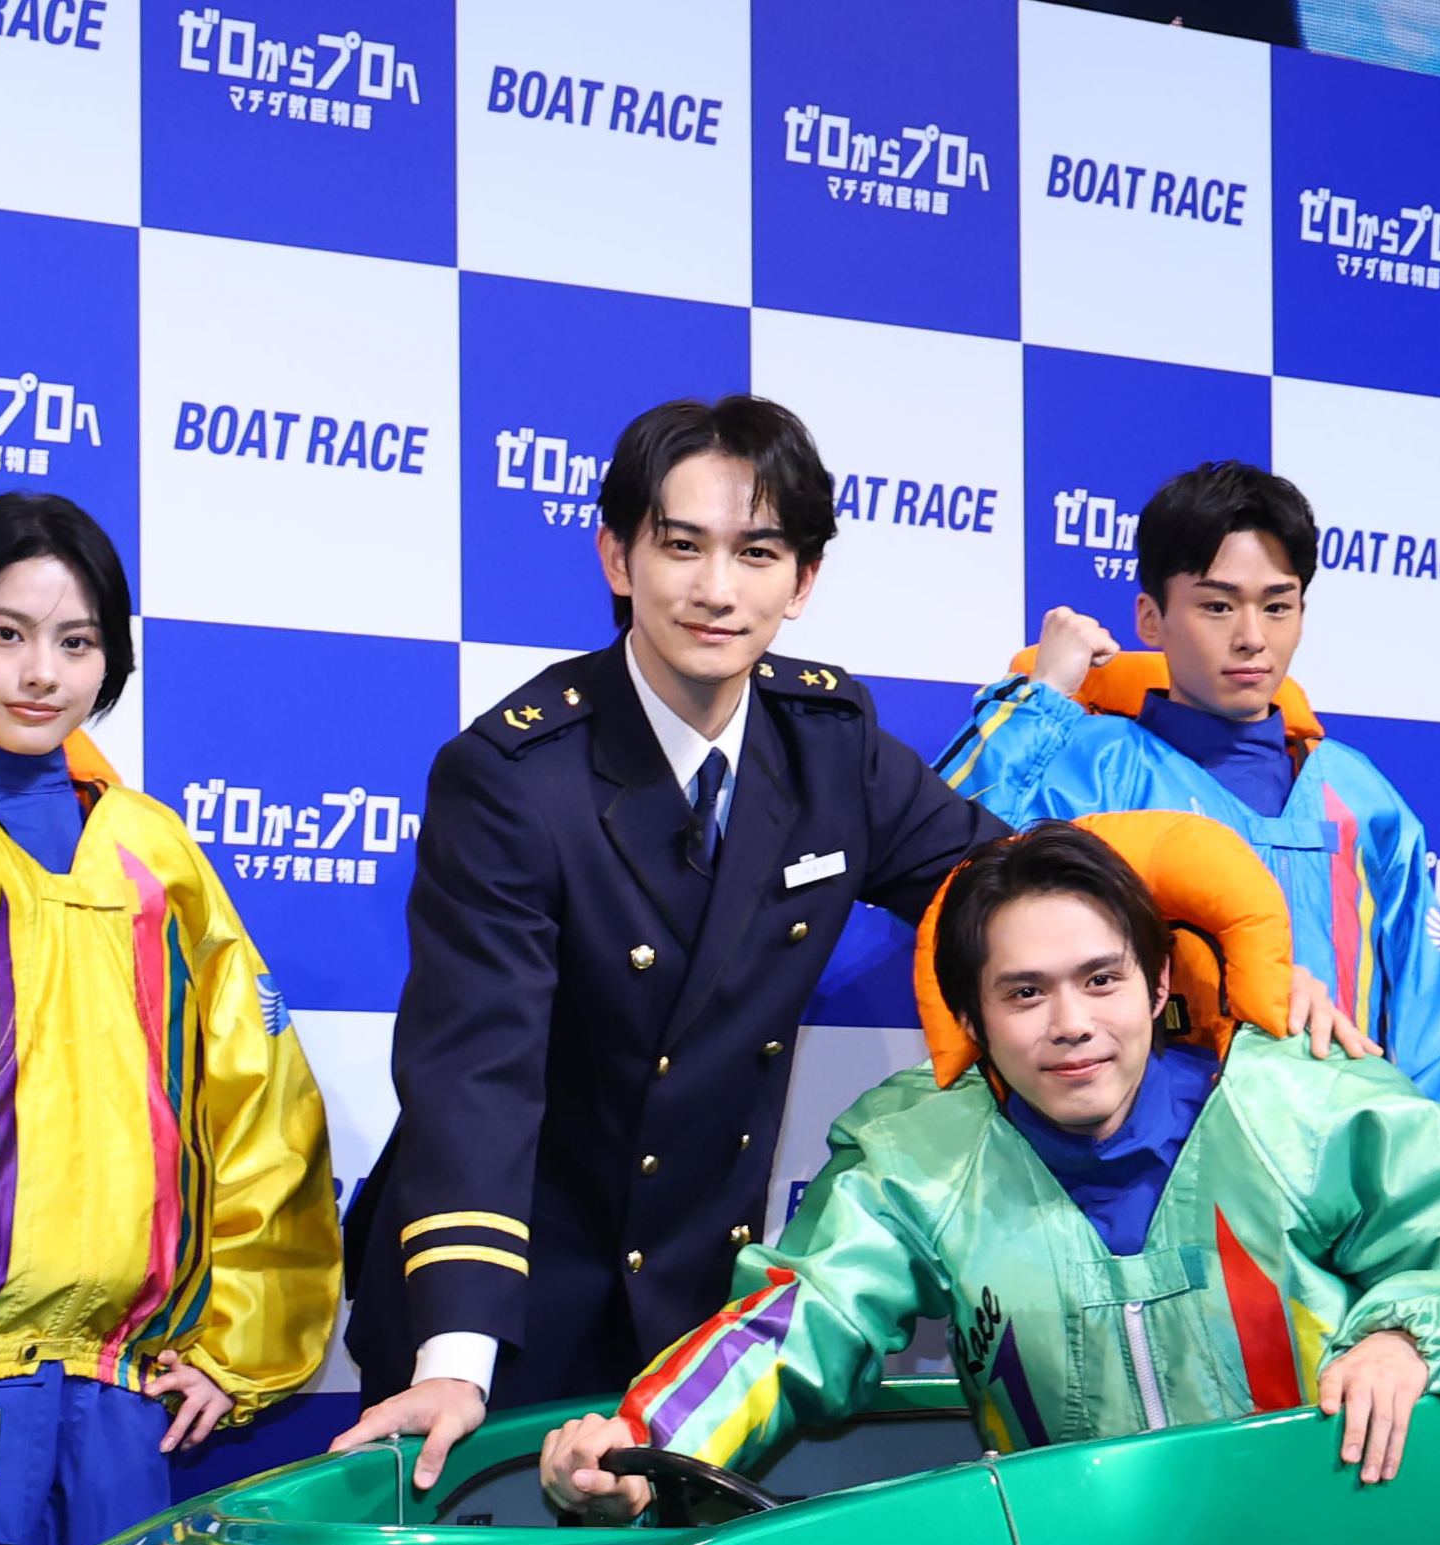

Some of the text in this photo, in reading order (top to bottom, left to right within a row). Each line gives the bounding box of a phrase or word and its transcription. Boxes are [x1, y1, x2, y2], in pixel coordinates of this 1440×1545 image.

[179, 9, 419, 104] ゼロからプロへ
[230, 86, 371, 129] マチダ教官物語
[487, 66, 722, 145] BOAT RACE
[785, 105, 989, 190] ゼロからプロへ
[828, 177, 948, 214] マチダ教官物語
[1047, 154, 1247, 226] BOAT RACE
[174, 402, 300, 460] BOAT
[307, 416, 428, 474] RACE
[828, 472, 888, 521] AT
[893, 479, 998, 533] RACE
[1315, 526, 1389, 573] OAT
[234, 854, 377, 884] マチダ教官物語
